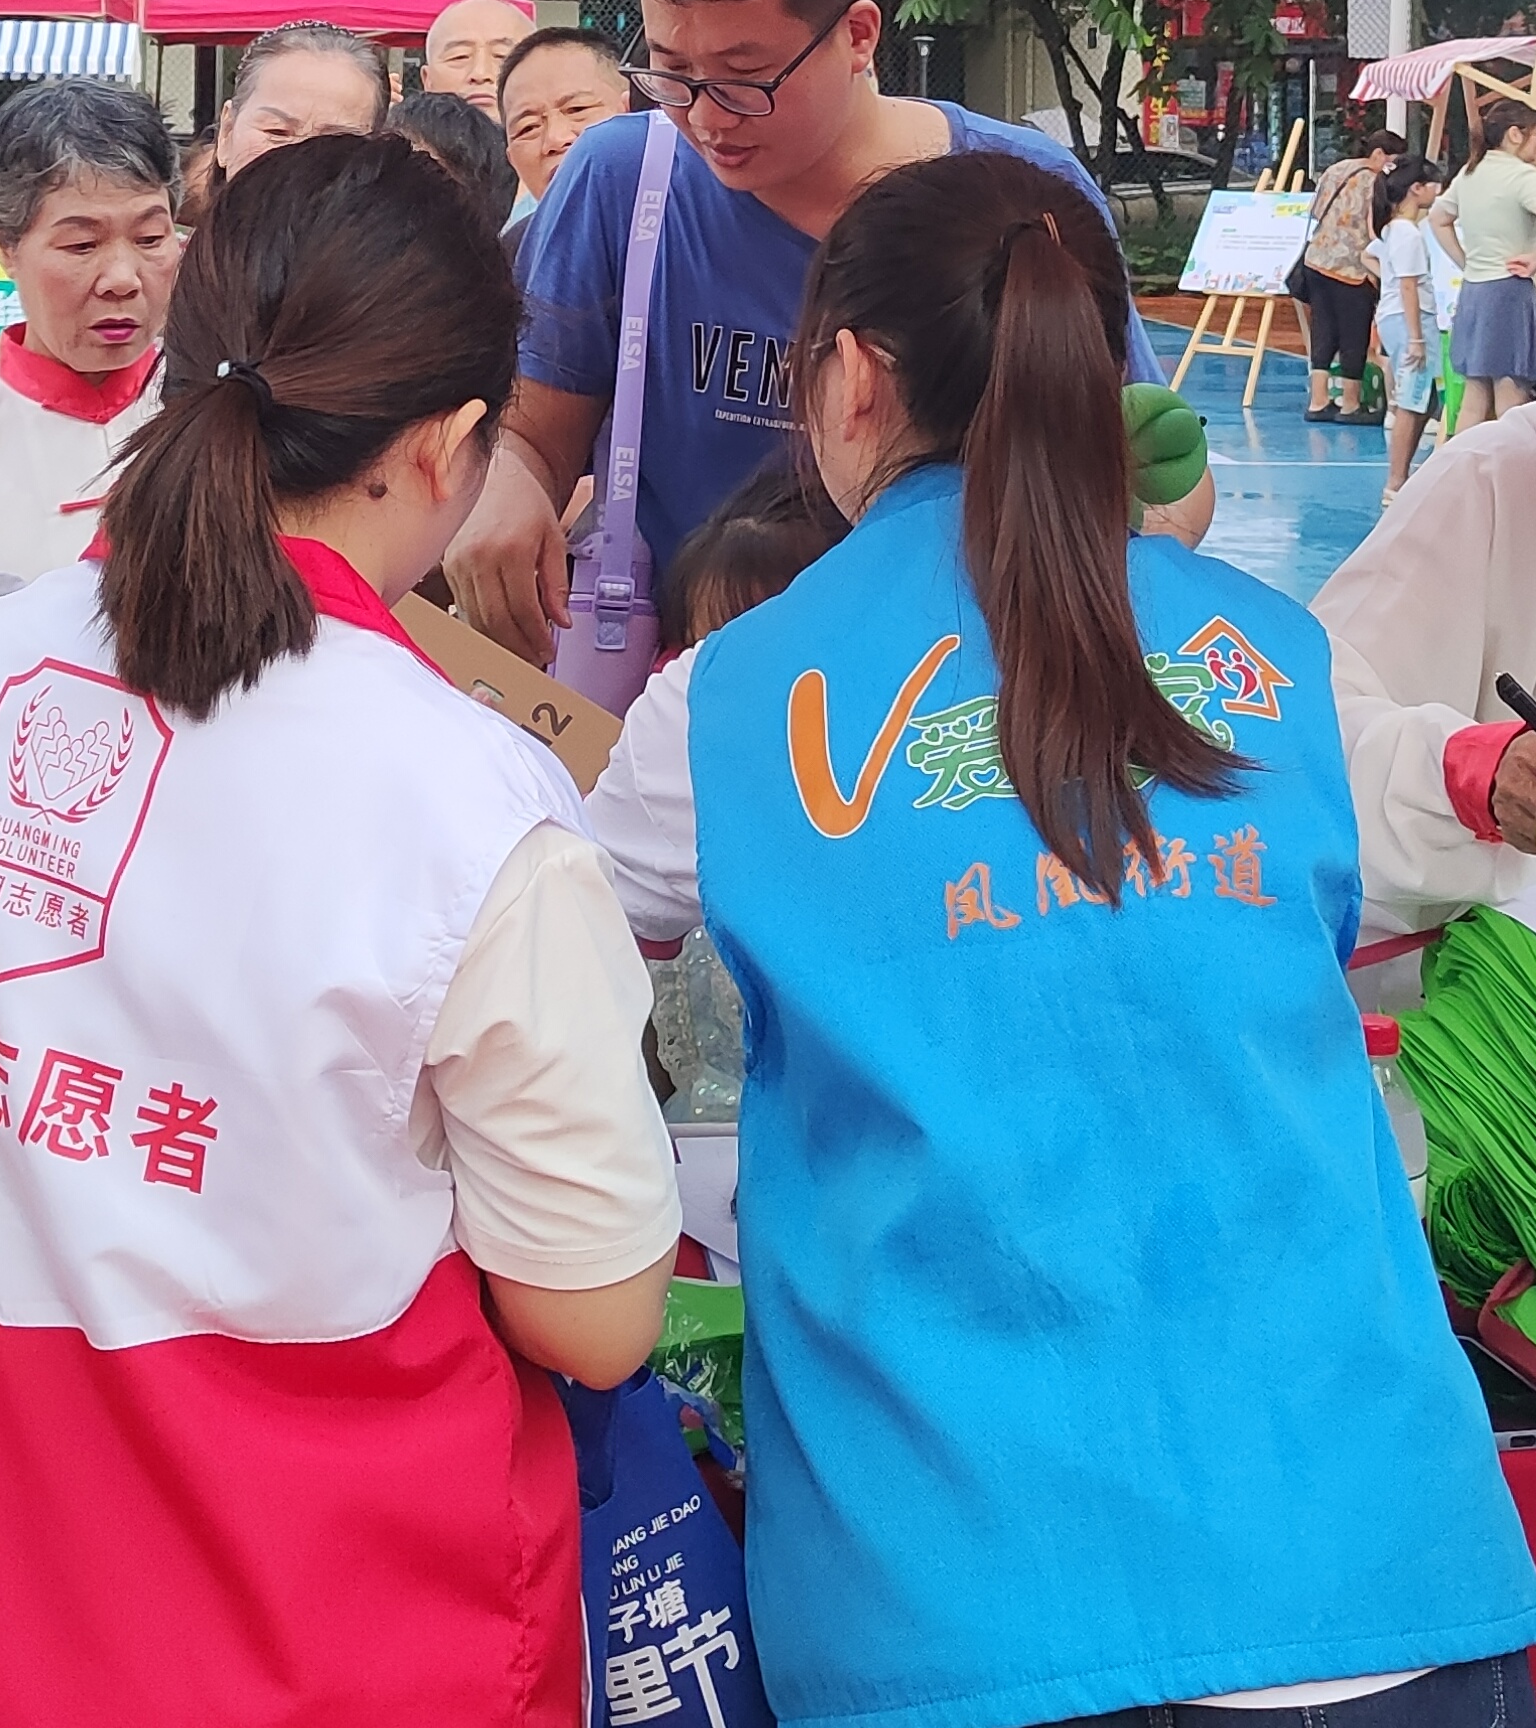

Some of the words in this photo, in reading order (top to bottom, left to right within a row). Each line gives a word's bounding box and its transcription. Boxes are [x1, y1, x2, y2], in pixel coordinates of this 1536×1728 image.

[635, 189, 663, 243] ELSA
[621, 316, 647, 371] ELSA
[611, 447, 635, 502] ELSA
[649, 1512, 670, 1535] JIE
[670, 1494, 701, 1523] DAO
[621, 1572, 647, 1596] LIN
[664, 1552, 686, 1574] JIE
[608, 1578, 689, 1645] 子塘
[606, 1605, 742, 1728] 里节
